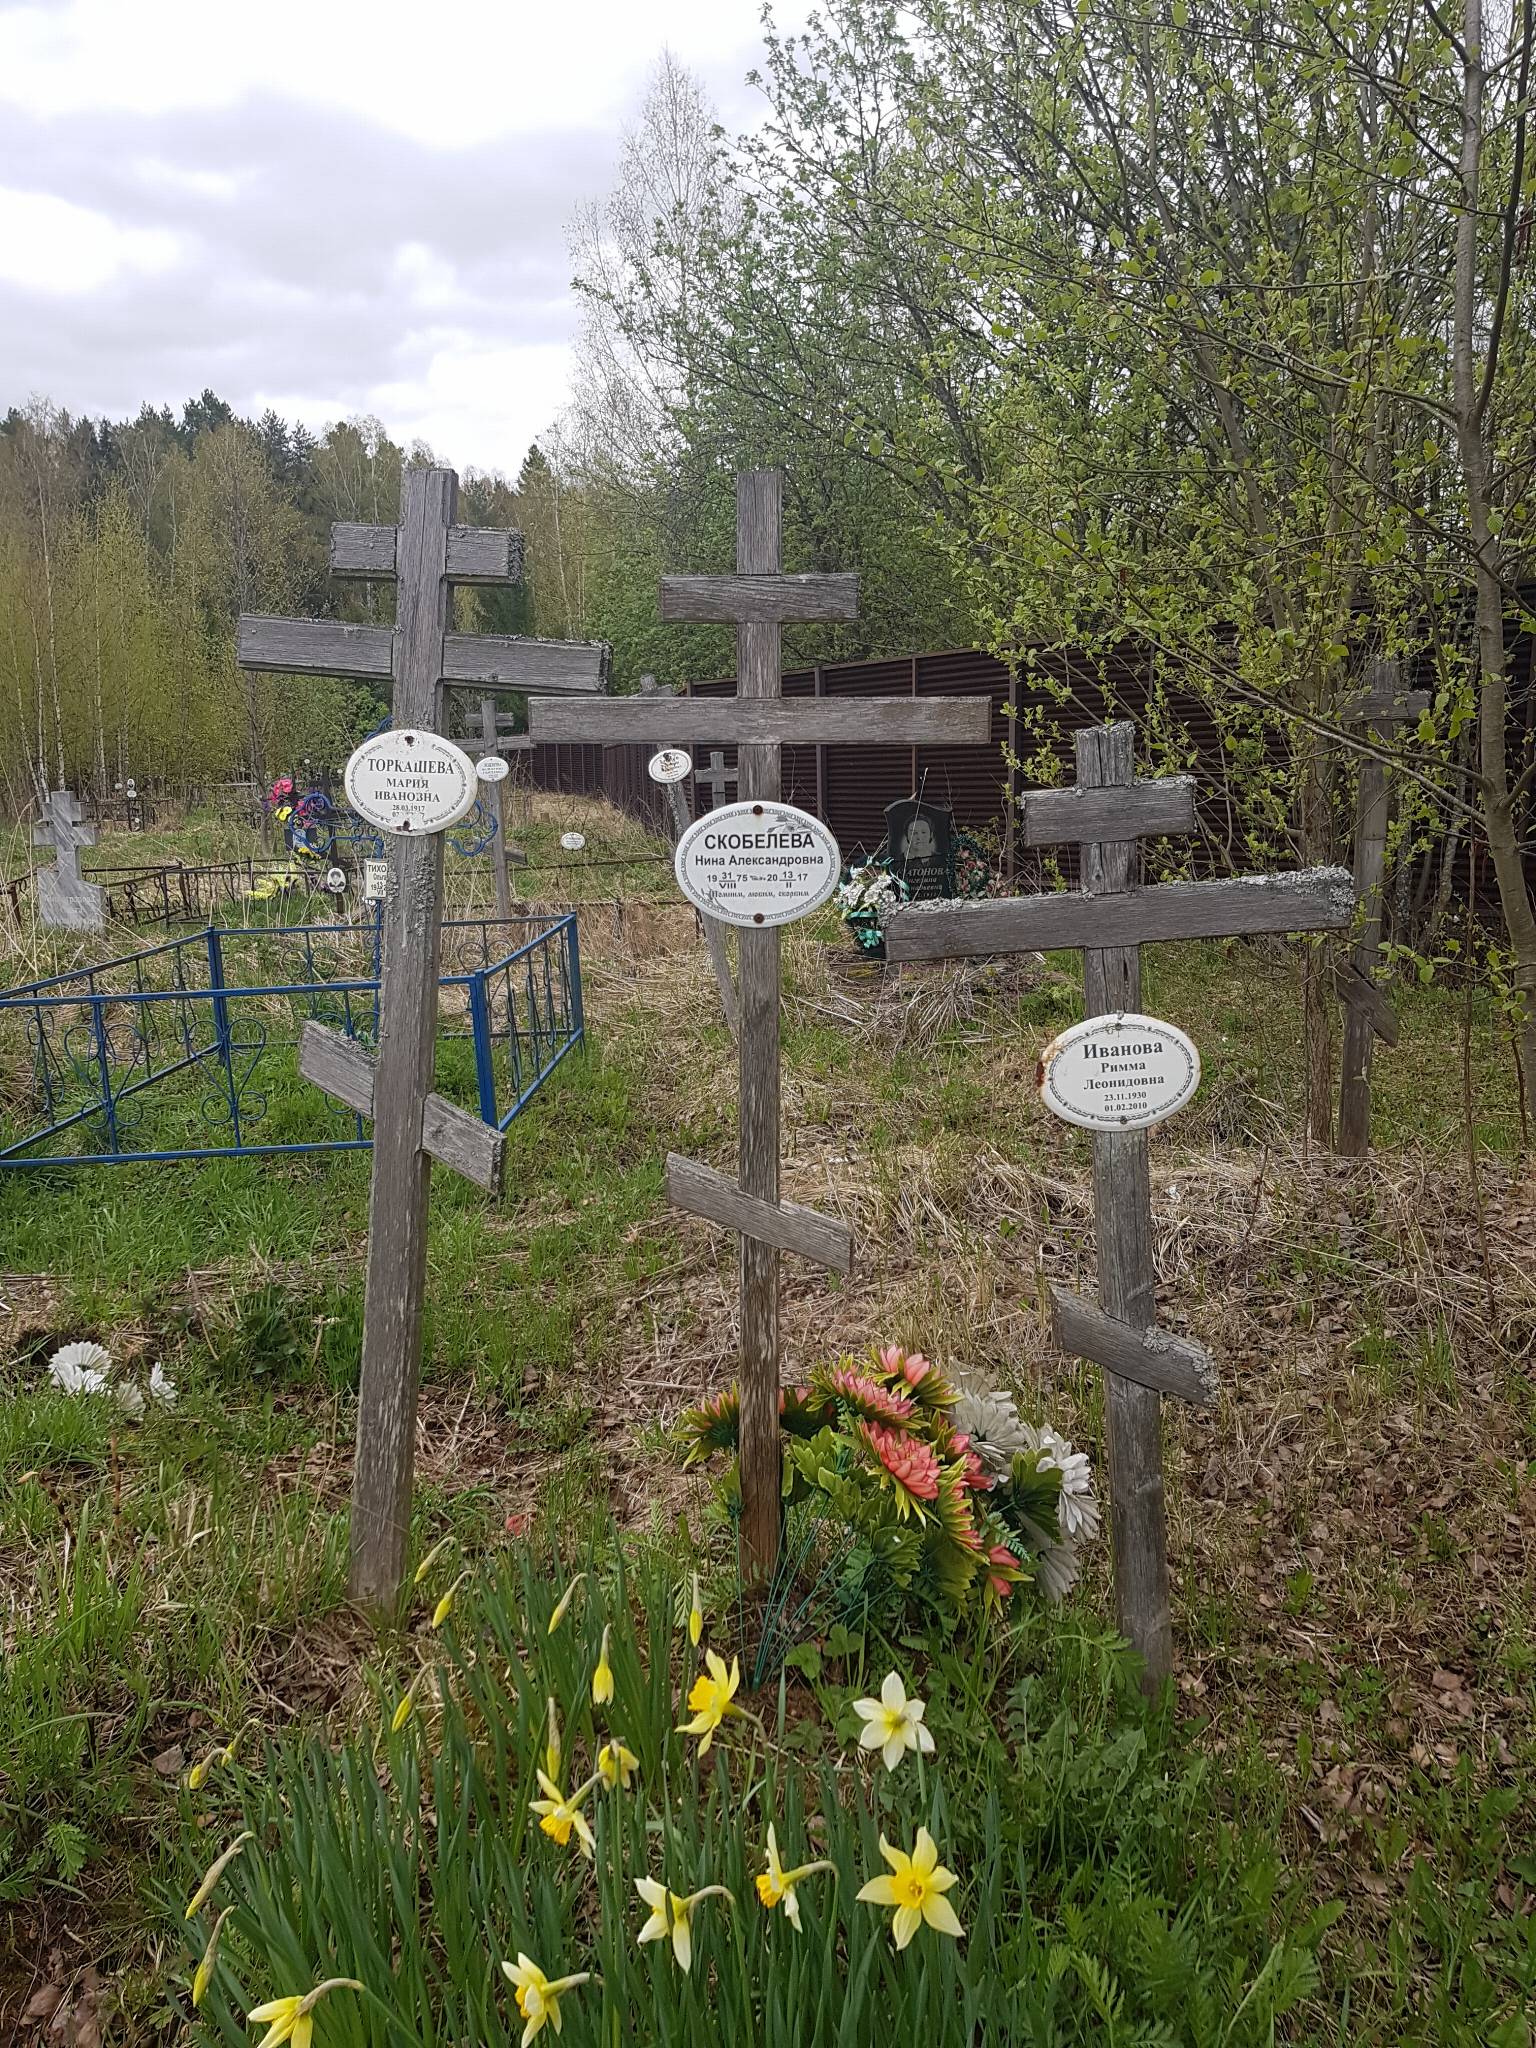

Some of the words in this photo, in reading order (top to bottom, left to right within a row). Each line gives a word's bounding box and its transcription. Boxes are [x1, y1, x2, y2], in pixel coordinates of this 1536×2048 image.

[386, 777, 429, 789] МАРИЯ
[704, 833, 815, 849] СКОБЕЛЕВА
[695, 855, 725, 866] Нина
[728, 855, 824, 868] Александровна
[368, 864, 387, 873] ТИХО
[1083, 1042, 1163, 1059] Иванова
[1101, 1062, 1146, 1073] Римма
[1083, 1076, 1165, 1090] Леонидовна
[1104, 1091, 1147, 1101] 23.11.1930
[1104, 1102, 1148, 1112] 01.02.2010
